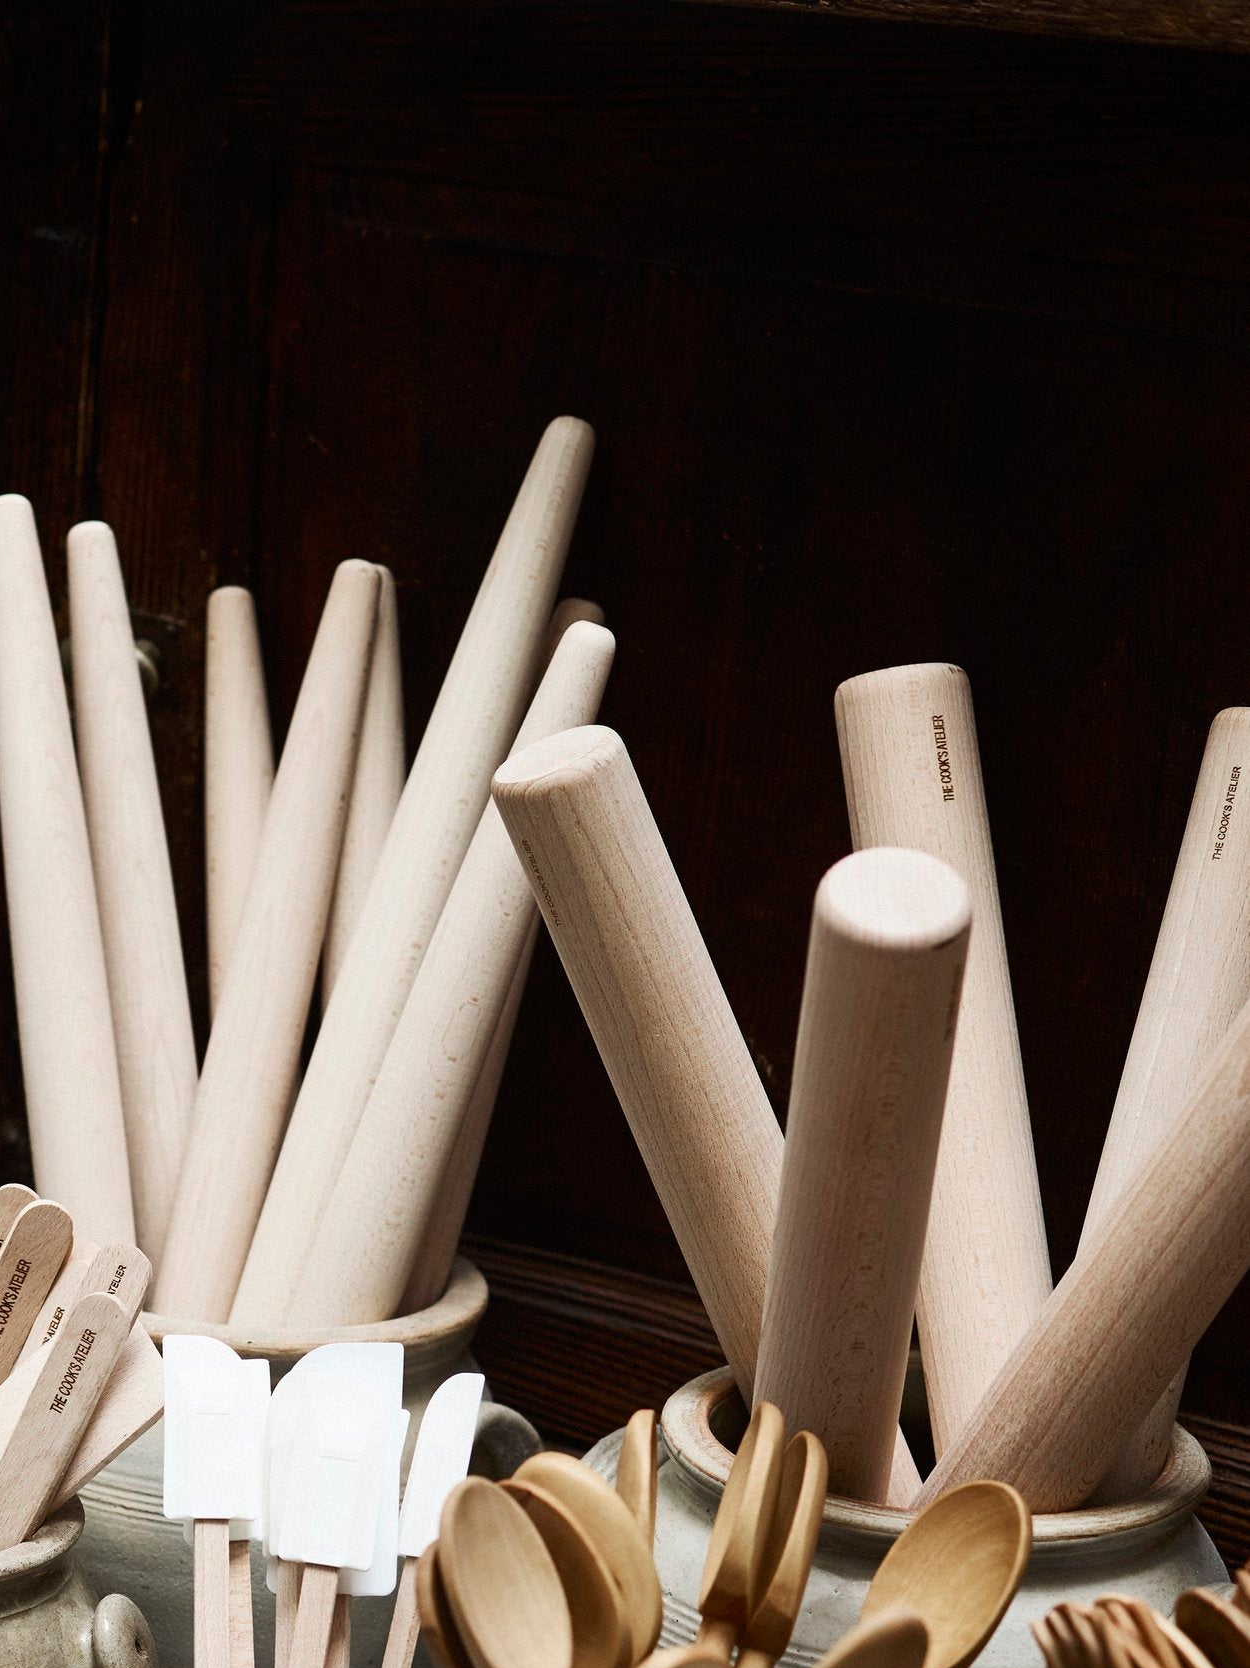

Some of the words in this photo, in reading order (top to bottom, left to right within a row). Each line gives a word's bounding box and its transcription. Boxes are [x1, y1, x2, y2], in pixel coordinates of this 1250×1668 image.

[932, 714, 948, 750] ATELIER
[937, 751, 952, 784] COOK'S
[1225, 766, 1242, 804] ATELIER
[942, 785, 955, 802] THE
[1217, 804, 1233, 840] COOK'S
[521, 840, 541, 875] ATELIER
[1212, 842, 1224, 860] THE
[551, 909, 562, 927] THE
[8, 1259, 32, 1295] ATELIER
[46, 1306, 65, 1338] ATELIER
[73, 1328, 97, 1366] ATELIER
[58, 1361, 82, 1396] COOK'S
[49, 1394, 68, 1414] THE
